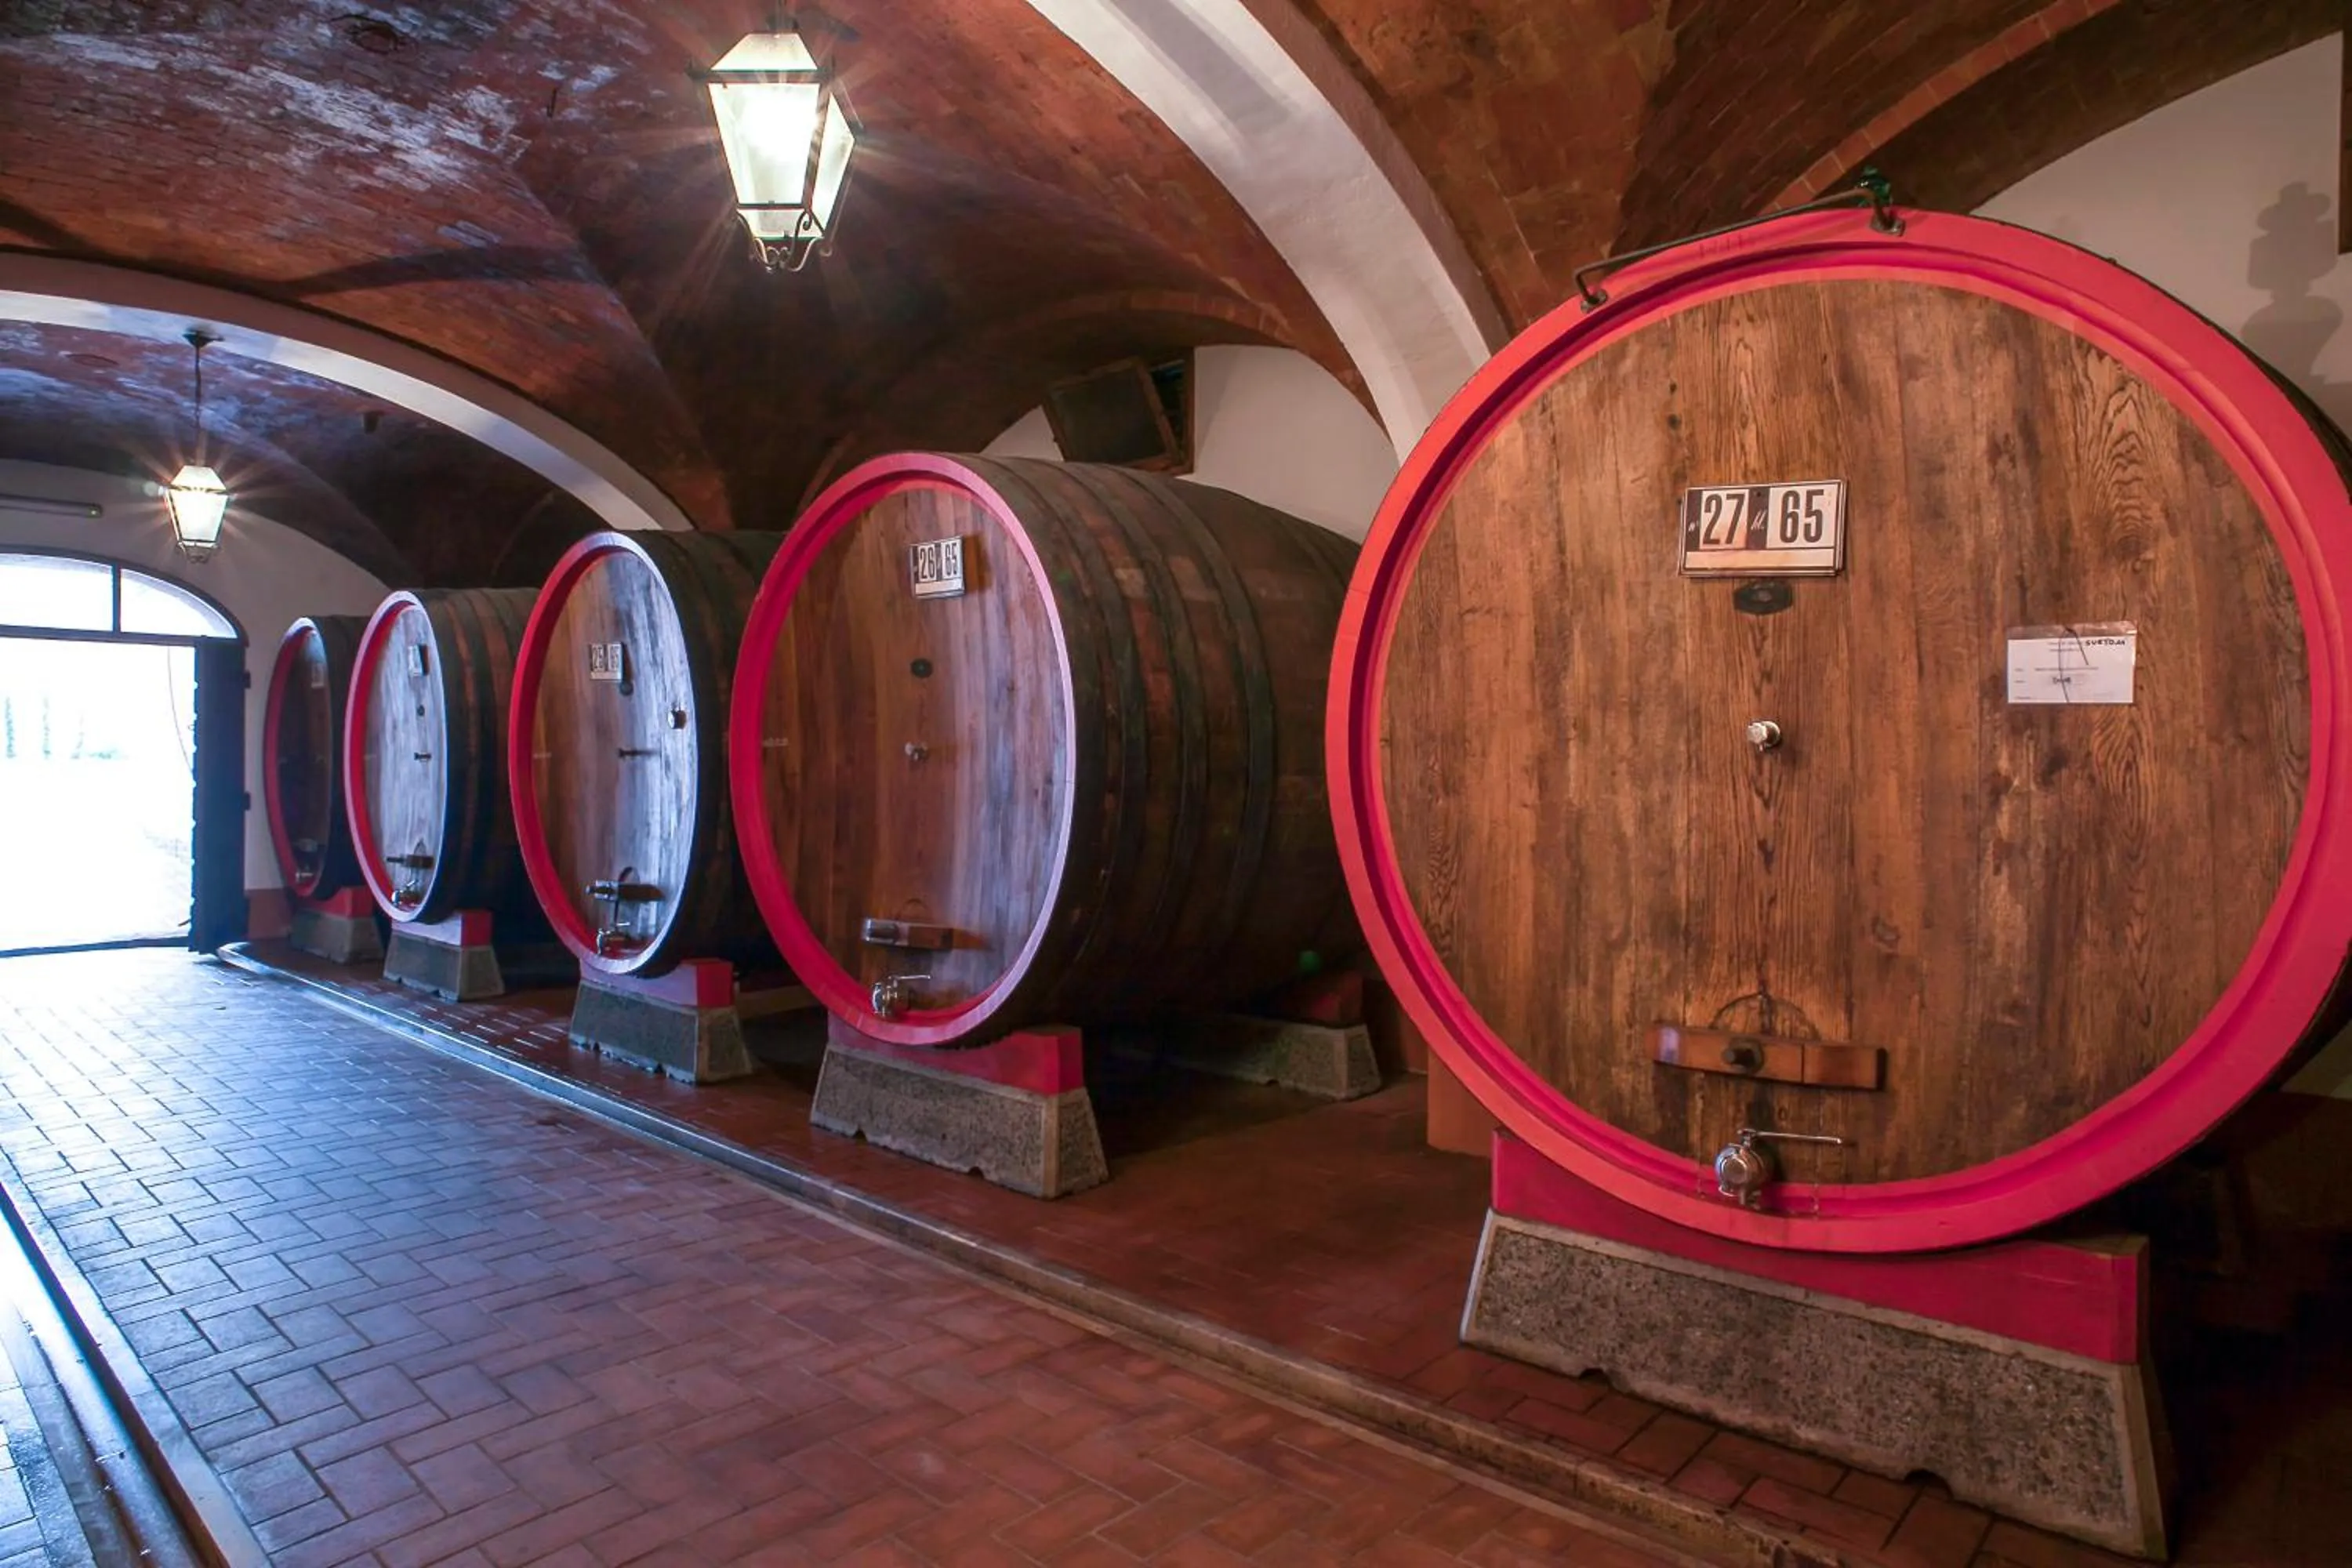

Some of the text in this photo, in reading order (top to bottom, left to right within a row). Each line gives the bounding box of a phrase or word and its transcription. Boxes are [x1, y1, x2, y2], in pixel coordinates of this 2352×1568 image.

[1703, 493, 1746, 545] 27
[1780, 488, 1824, 543] 65
[920, 543, 957, 579] 26 65
